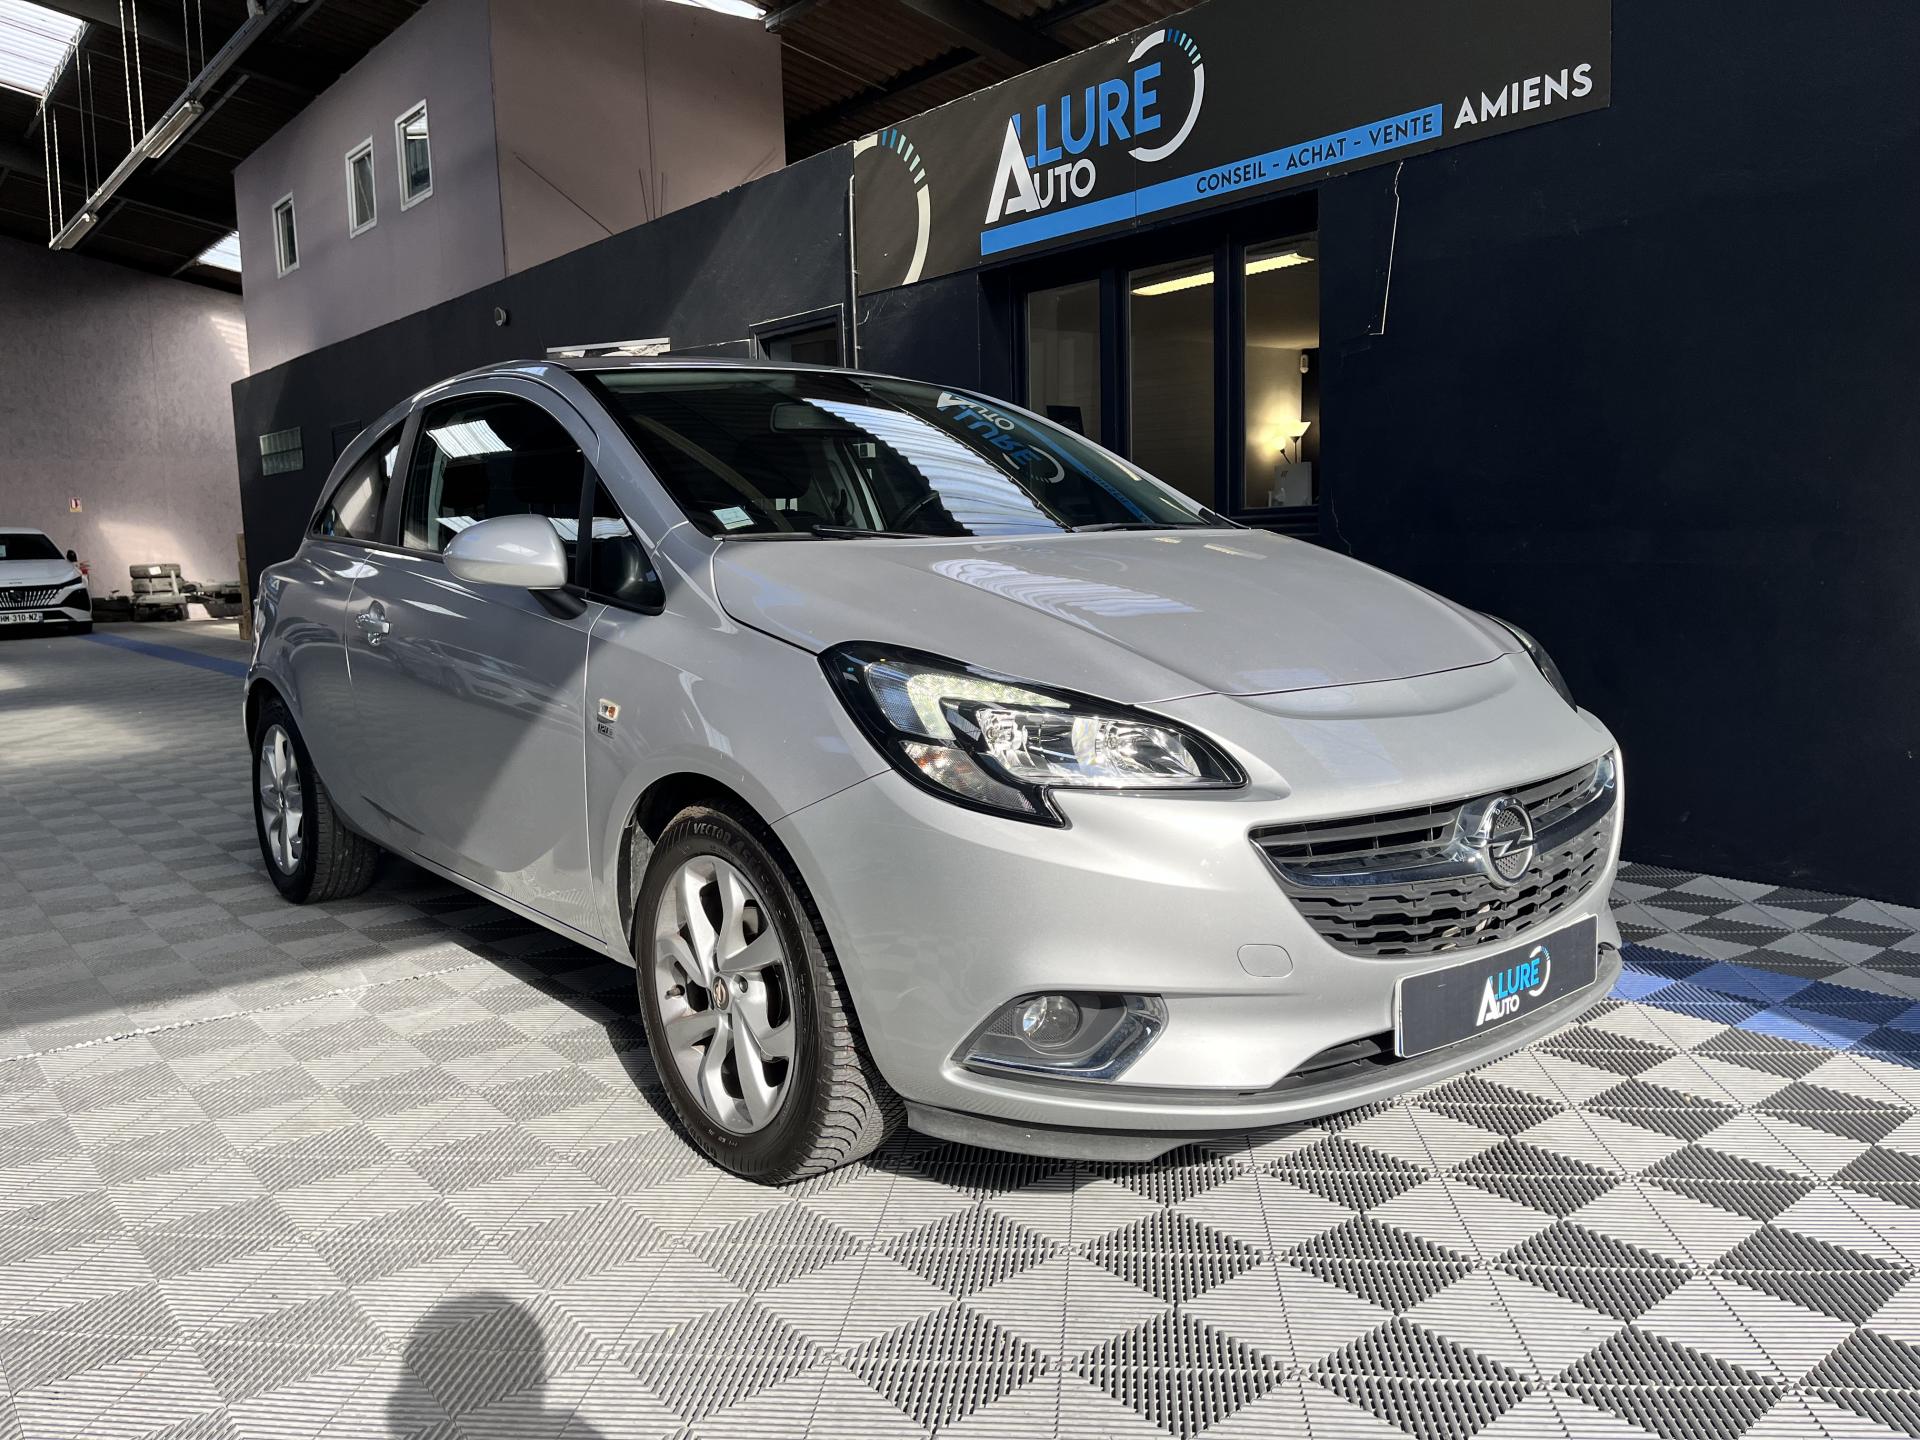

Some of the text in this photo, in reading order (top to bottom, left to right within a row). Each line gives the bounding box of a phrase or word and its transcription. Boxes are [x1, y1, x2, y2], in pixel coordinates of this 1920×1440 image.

[1453, 63, 1593, 129] AMIENS
[1196, 158, 1267, 194] CONSEIL
[1286, 137, 1348, 171] ACHAT
[1368, 112, 1434, 147] VENTE
[693, 822, 733, 845] VECTOR
